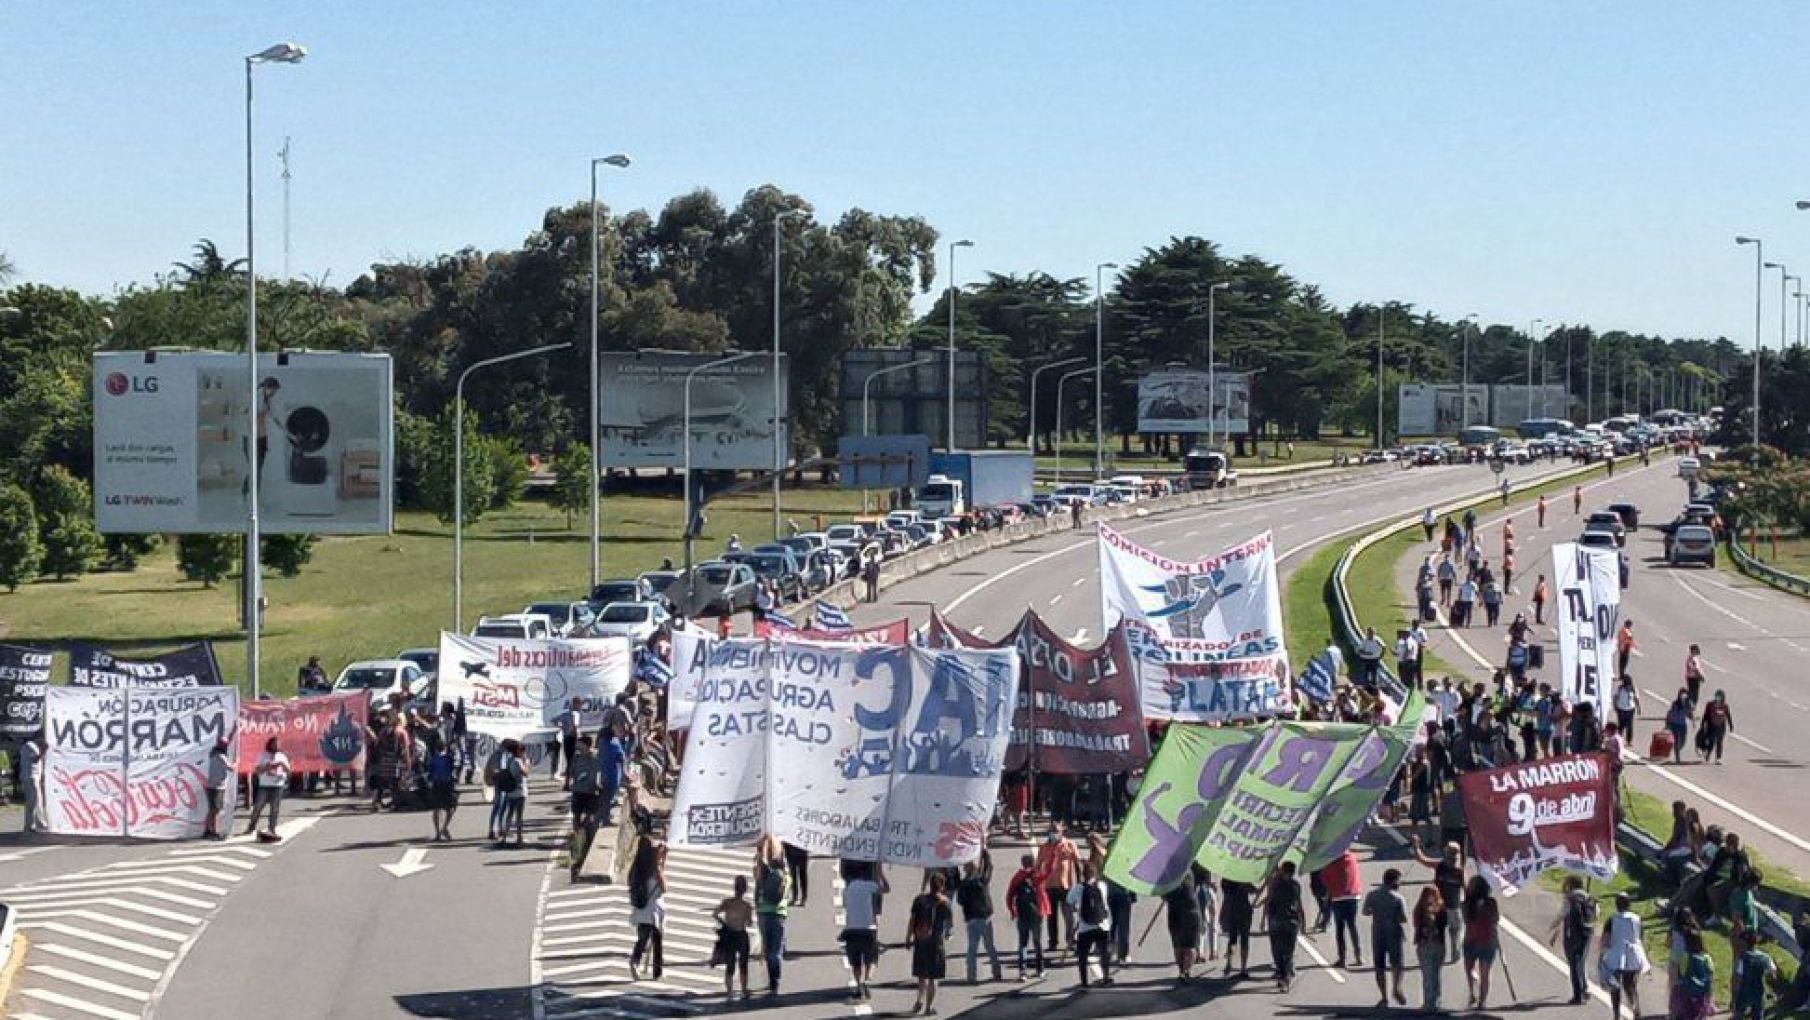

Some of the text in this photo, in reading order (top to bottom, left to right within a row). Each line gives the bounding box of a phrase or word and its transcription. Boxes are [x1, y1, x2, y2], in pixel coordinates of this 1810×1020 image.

[132, 375, 159, 393] LG
[105, 495, 122, 506] LG
[1490, 754, 1600, 791] LA MARRÓN
[1507, 791, 1597, 835] 9 de abril
